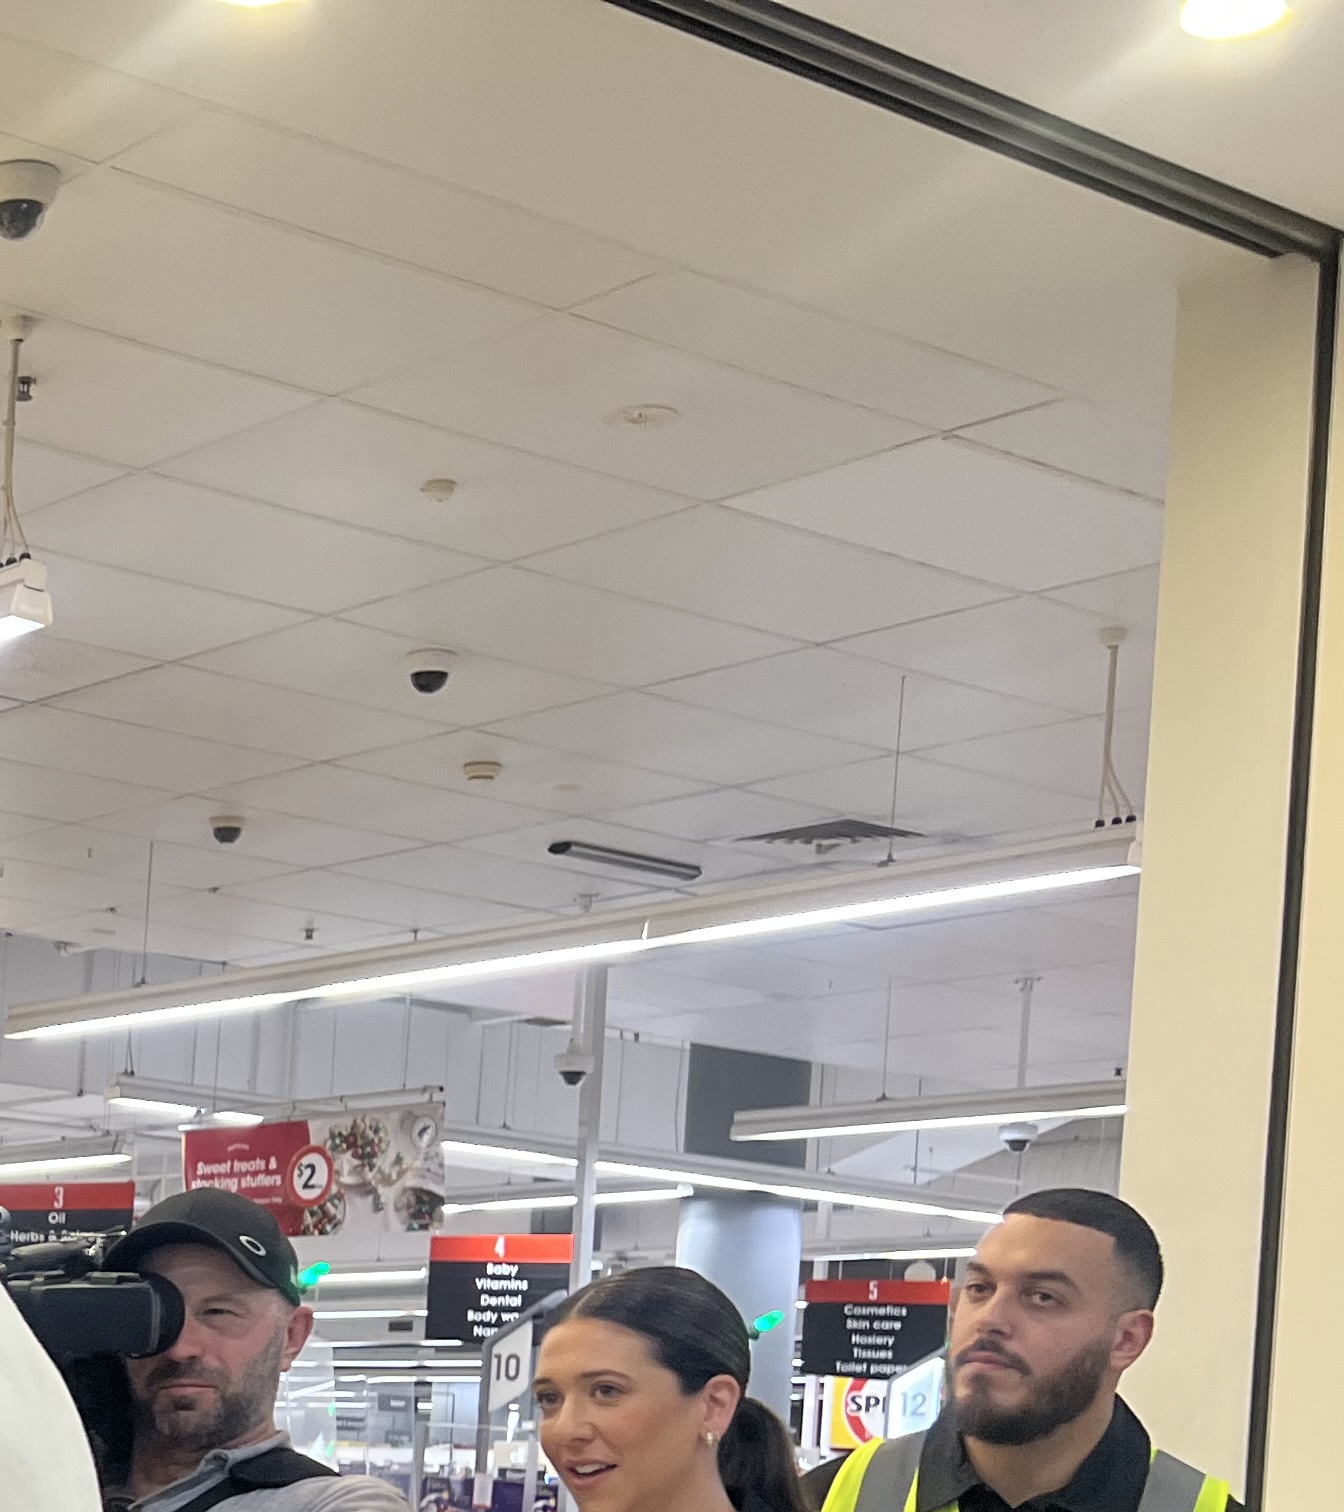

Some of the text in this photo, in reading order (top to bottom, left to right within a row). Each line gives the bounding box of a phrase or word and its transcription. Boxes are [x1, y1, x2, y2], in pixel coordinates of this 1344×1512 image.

[197, 1156, 277, 1175] Sweet treats &
[192, 1174, 282, 1192] stocking stuffers
[297, 1163, 316, 1190] $2
[54, 1186, 64, 1209] 3
[48, 1212, 66, 1224] Oil
[11, 1230, 45, 1242] Herbs
[494, 1236, 505, 1258] 4
[486, 1263, 519, 1277] Baby
[475, 1277, 529, 1291] Vitamins
[869, 1280, 878, 1300] 5
[480, 1294, 522, 1307] Dental
[467, 1310, 498, 1323] Body
[844, 1304, 907, 1317] Cosmetics
[846, 1318, 902, 1330] Skin care
[851, 1333, 895, 1346] Hosiery
[853, 1348, 893, 1360] Tissues
[493, 1353, 520, 1382] 10
[835, 1361, 867, 1373] Toilet
[900, 1391, 927, 1417] 12
